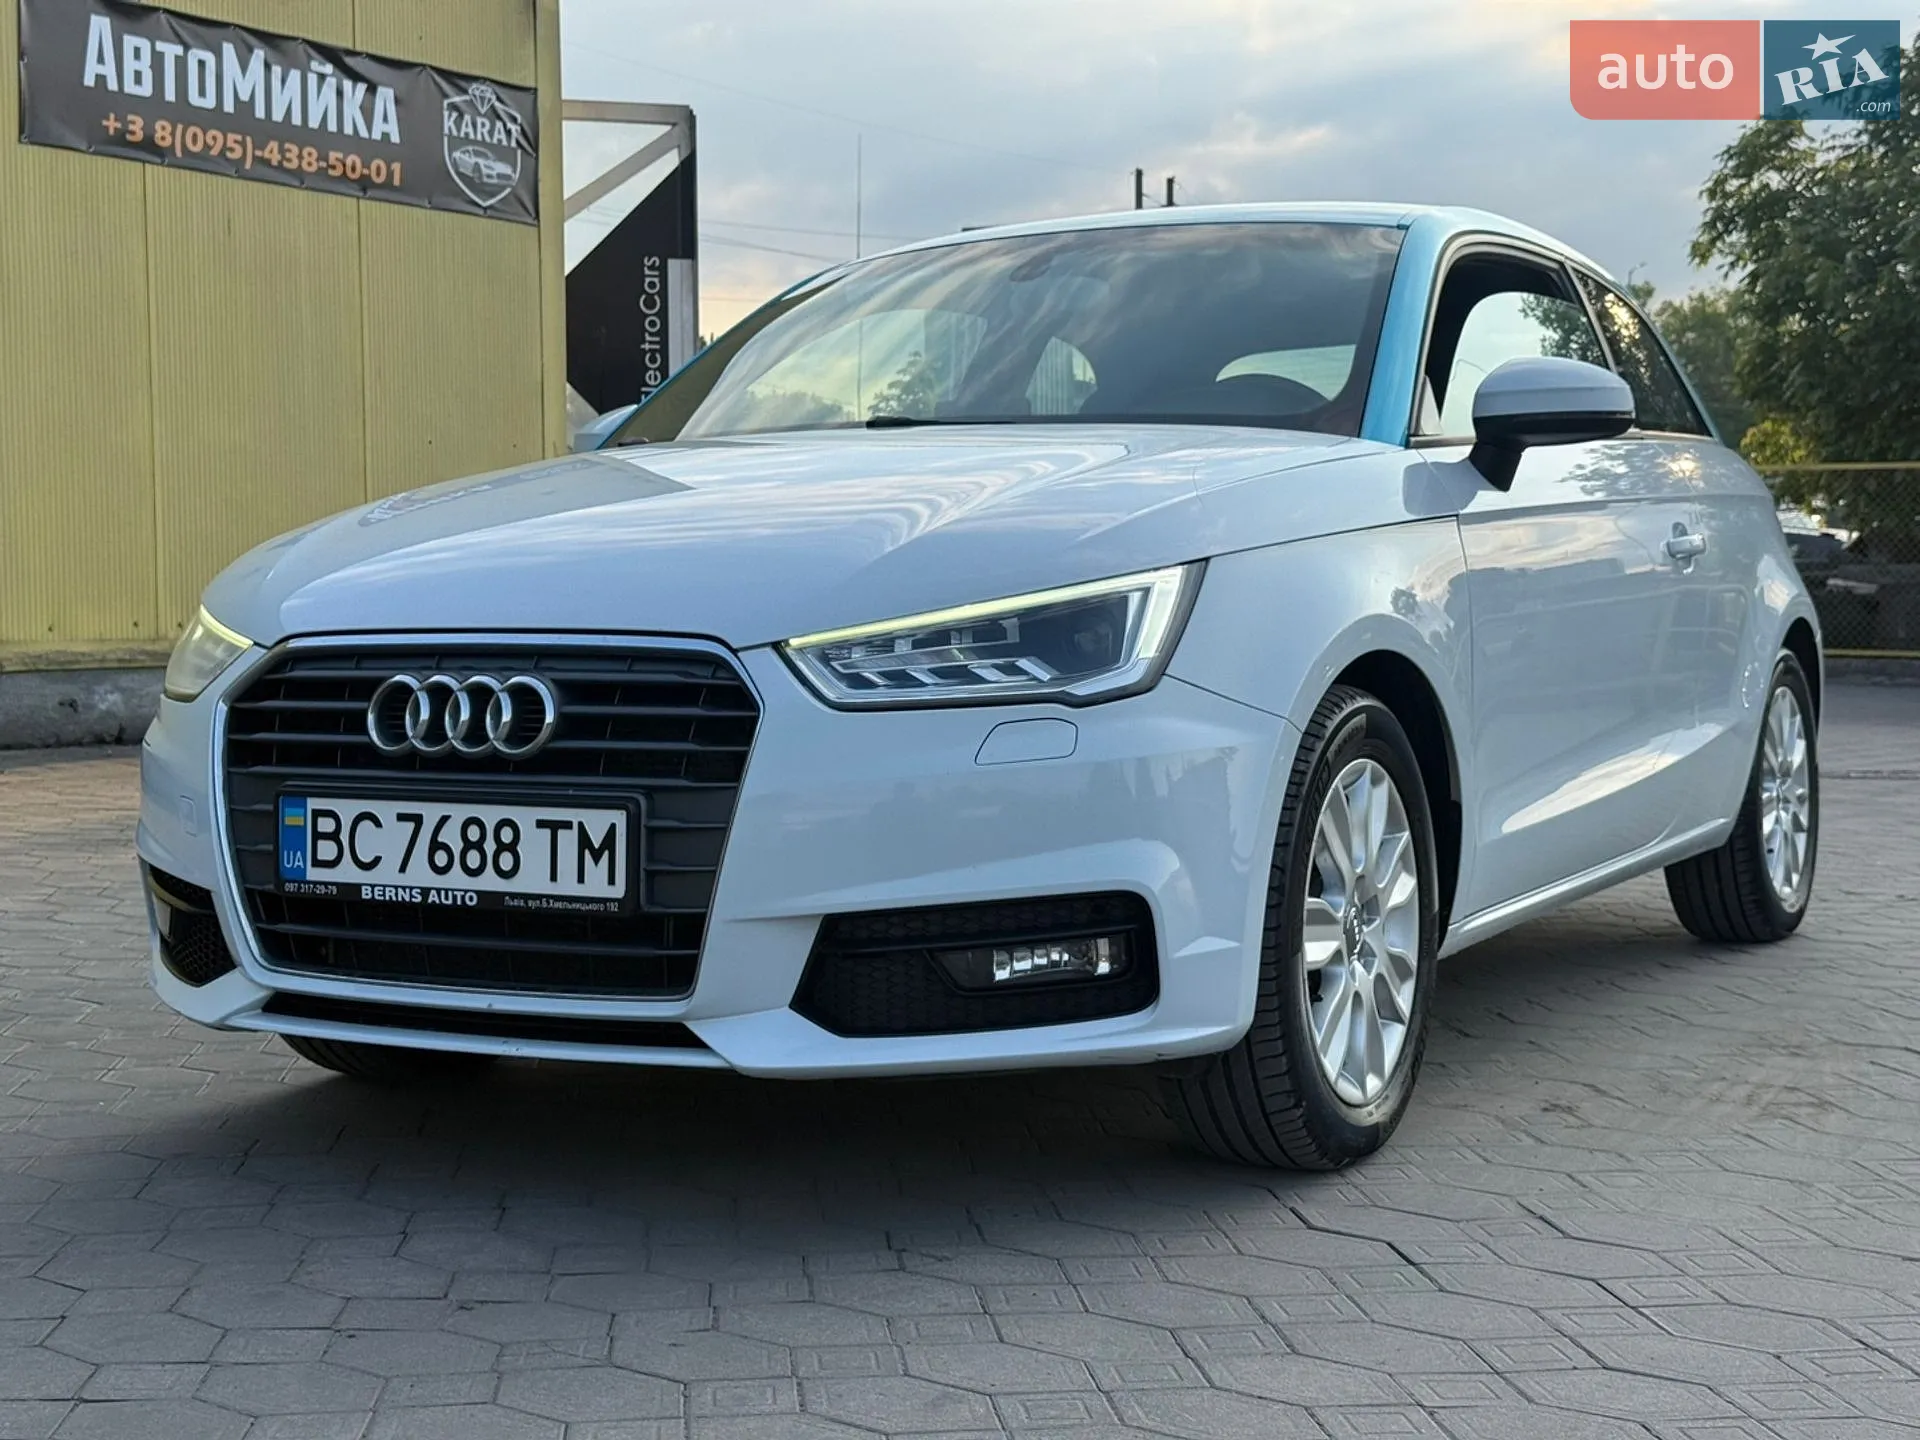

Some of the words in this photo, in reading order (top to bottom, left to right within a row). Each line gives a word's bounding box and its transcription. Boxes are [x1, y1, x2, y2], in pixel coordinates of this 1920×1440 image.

[443, 110, 521, 148] KARAT
[284, 849, 305, 869] UA
[310, 808, 383, 873] BC
[396, 812, 521, 880] 7688
[535, 819, 617, 887] TM
[361, 884, 422, 904] BERNS
[427, 887, 478, 907] AUTO
